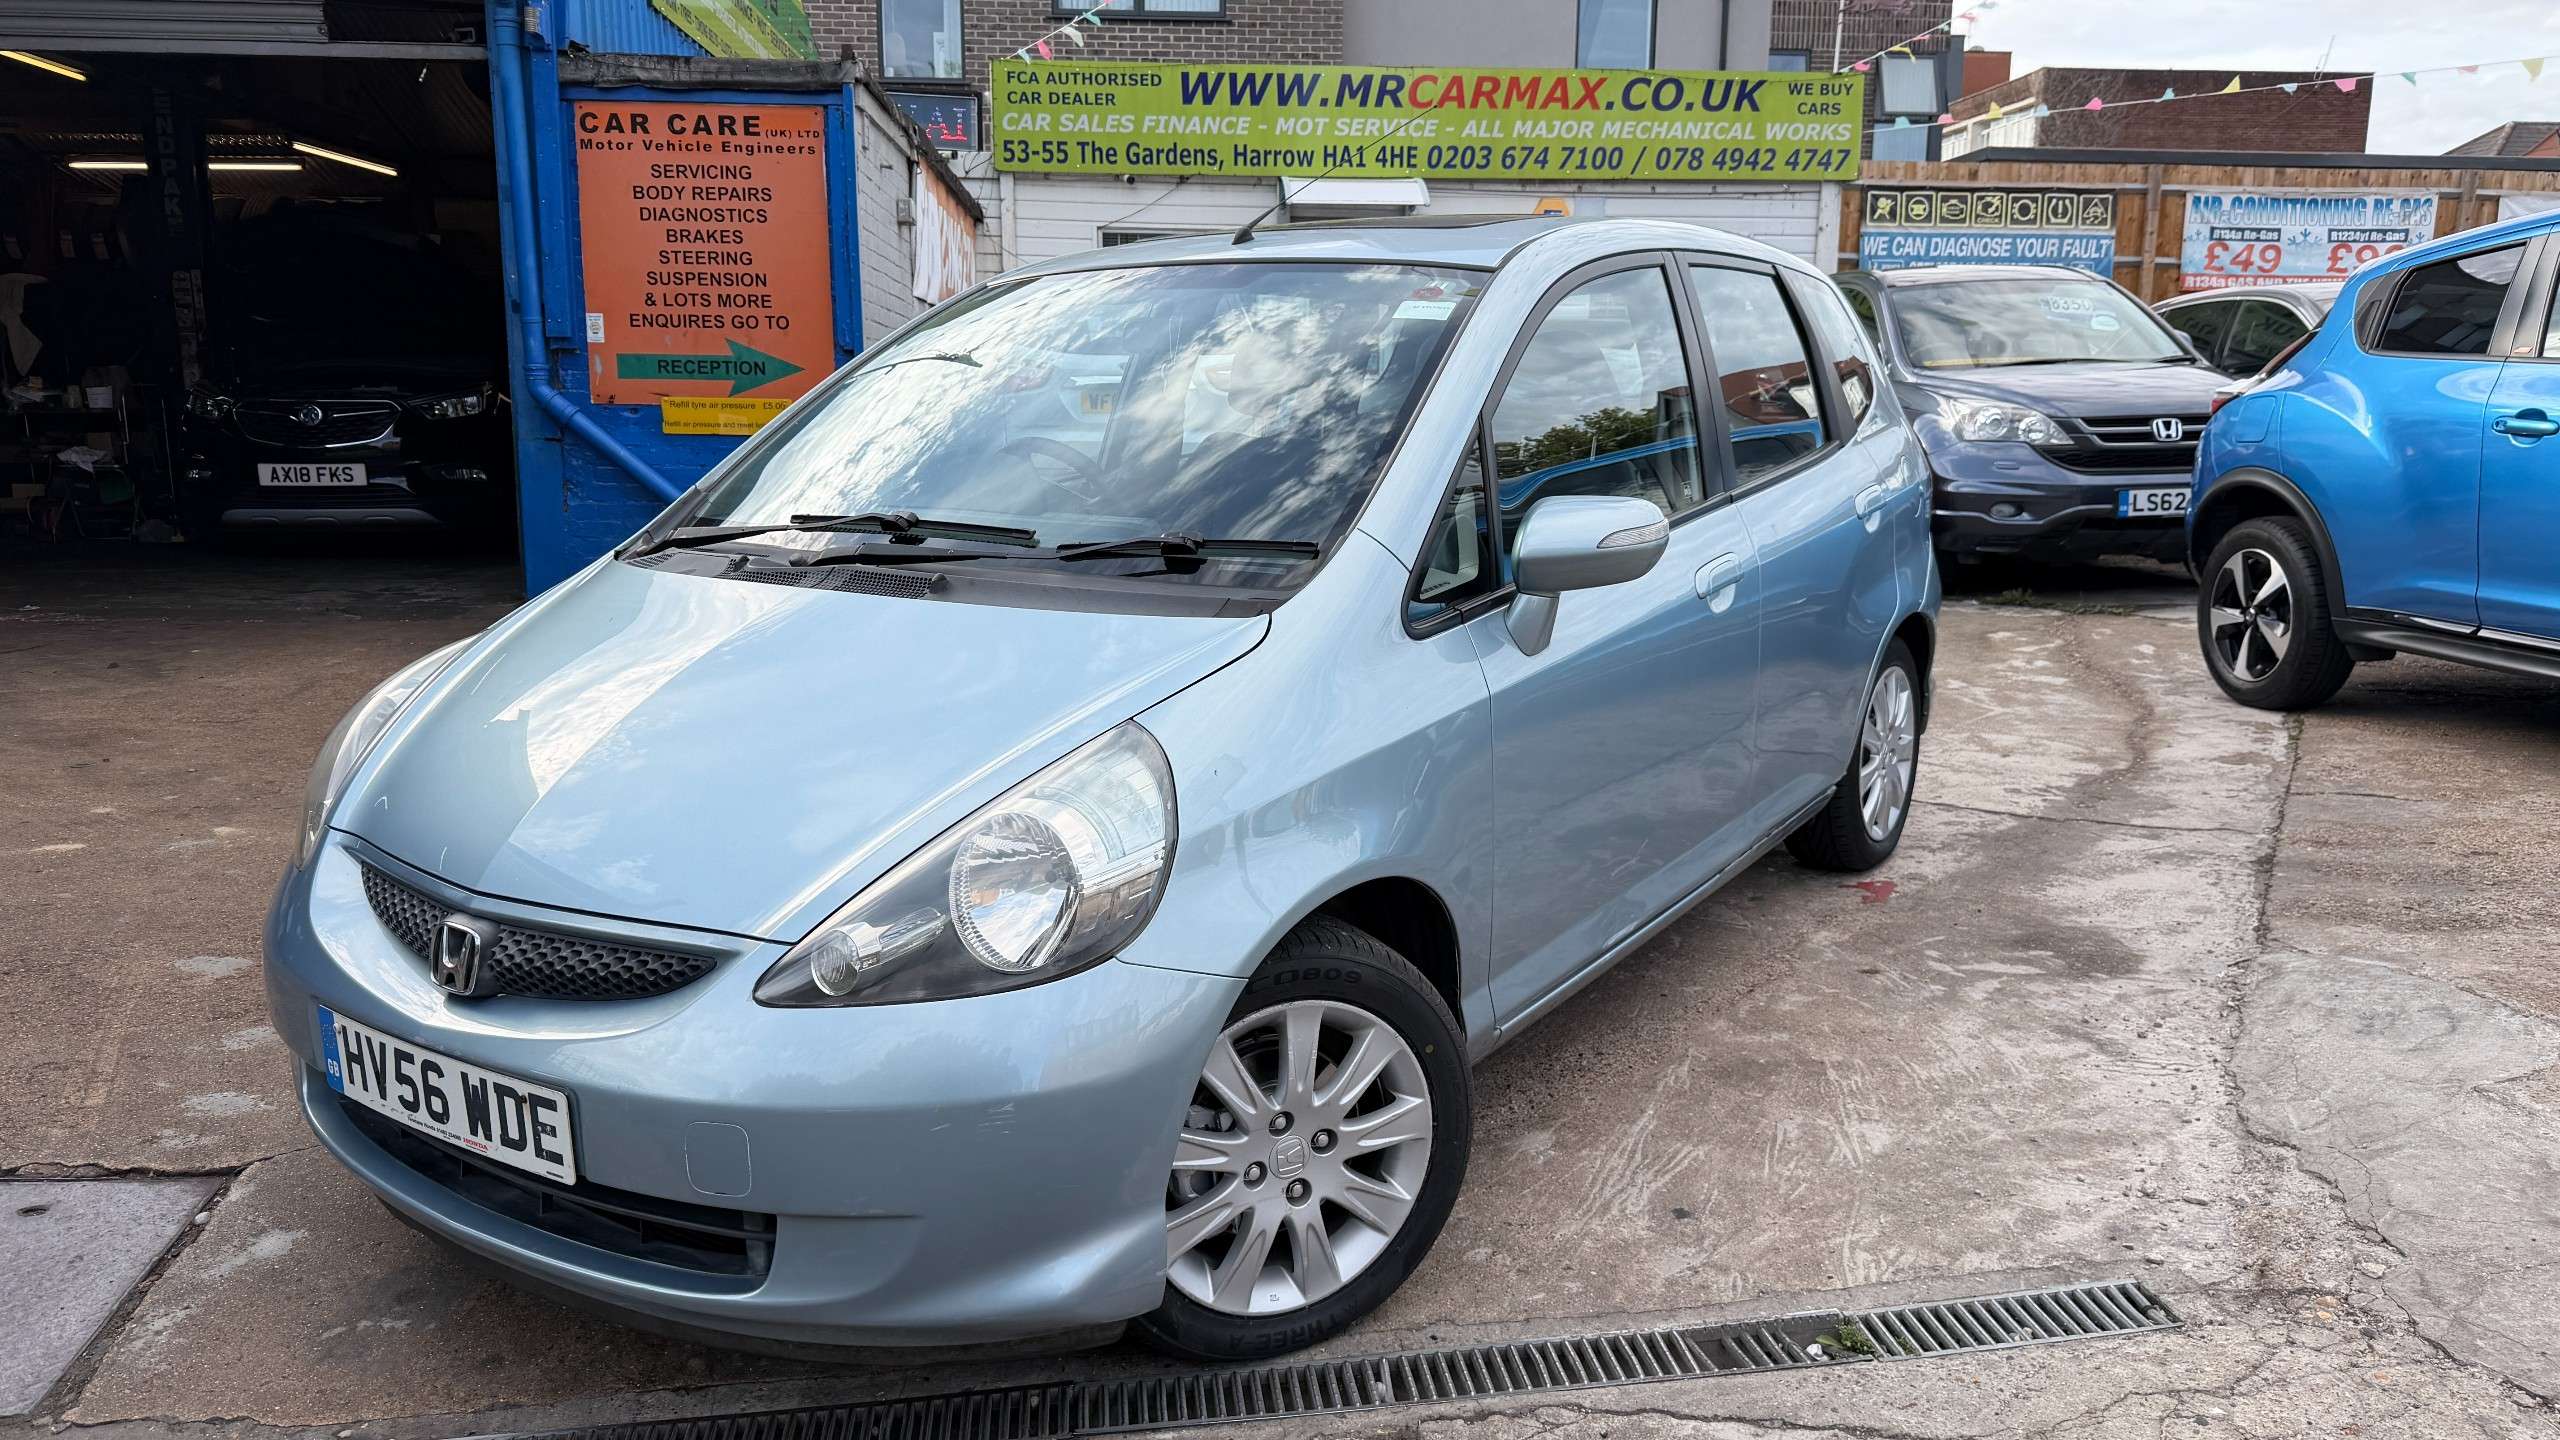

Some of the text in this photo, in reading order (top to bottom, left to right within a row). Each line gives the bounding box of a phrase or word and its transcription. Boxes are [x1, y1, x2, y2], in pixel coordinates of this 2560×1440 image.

[1006, 70, 1162, 88] FCA AUTHORISED
[1006, 90, 1117, 106] CAR DEALER
[1180, 71, 1767, 112] WWW.MRCARMAX.CO.UK
[1788, 82, 1854, 96] WE BUY
[1796, 102, 1842, 116] CARS
[578, 111, 821, 140] CAR CARE (UK) LTD
[1002, 112, 1051, 132] CAR
[1057, 113, 1135, 134] SALES
[1142, 114, 1251, 136] FINANCE
[1274, 117, 1329, 137] MOT
[1333, 117, 1438, 138] SERVICE
[1460, 119, 1503, 138] ALL
[1512, 120, 1593, 140] MAJOR
[1600, 121, 1756, 141] MECHANICAL
[1764, 122, 1852, 142] WORKS
[579, 138, 817, 157] Motor Vehicle Engineers
[1002, 138, 1069, 165] 53-55
[1076, 140, 1118, 167] The
[1124, 141, 1225, 171] Gardens,
[1232, 143, 1315, 169] Harrow
[1322, 144, 1366, 169] HA1
[1374, 145, 1418, 169] 4HE
[1426, 144, 1493, 170] 0203
[1500, 146, 1550, 170] 674
[1558, 146, 1624, 171] 7100
[1654, 146, 1704, 171] 078
[1711, 147, 1778, 172] 4942
[1783, 148, 1851, 173] 4747
[650, 163, 753, 180] SERVICING
[632, 185, 773, 202] BODY REPAIRS
[639, 206, 768, 224] DIAGNOSTICS
[2189, 195, 2433, 226] AIR-CONDITIONING RE-GAS
[665, 229, 744, 245] BRAKES
[1863, 236, 1888, 256] WE
[1892, 236, 1927, 257] CAN
[1929, 237, 2012, 258] DIAGNOSE
[2015, 238, 2059, 258] YOUR
[658, 250, 754, 266] STEERING
[2203, 242, 2282, 274] £49
[2326, 242, 2405, 274] £9
[646, 271, 768, 288] SUSPENSION
[644, 292, 773, 309] & LOTS MORE
[629, 313, 791, 331] ENQUIRES GO TO
[656, 359, 767, 377] RECEPTION
[720, 401, 757, 411] pressure
[270, 466, 354, 483] AX18 FKS
[2133, 492, 2187, 512] LS62
[327, 1058, 340, 1077] GB
[341, 1024, 565, 1167] HV56 WDE
